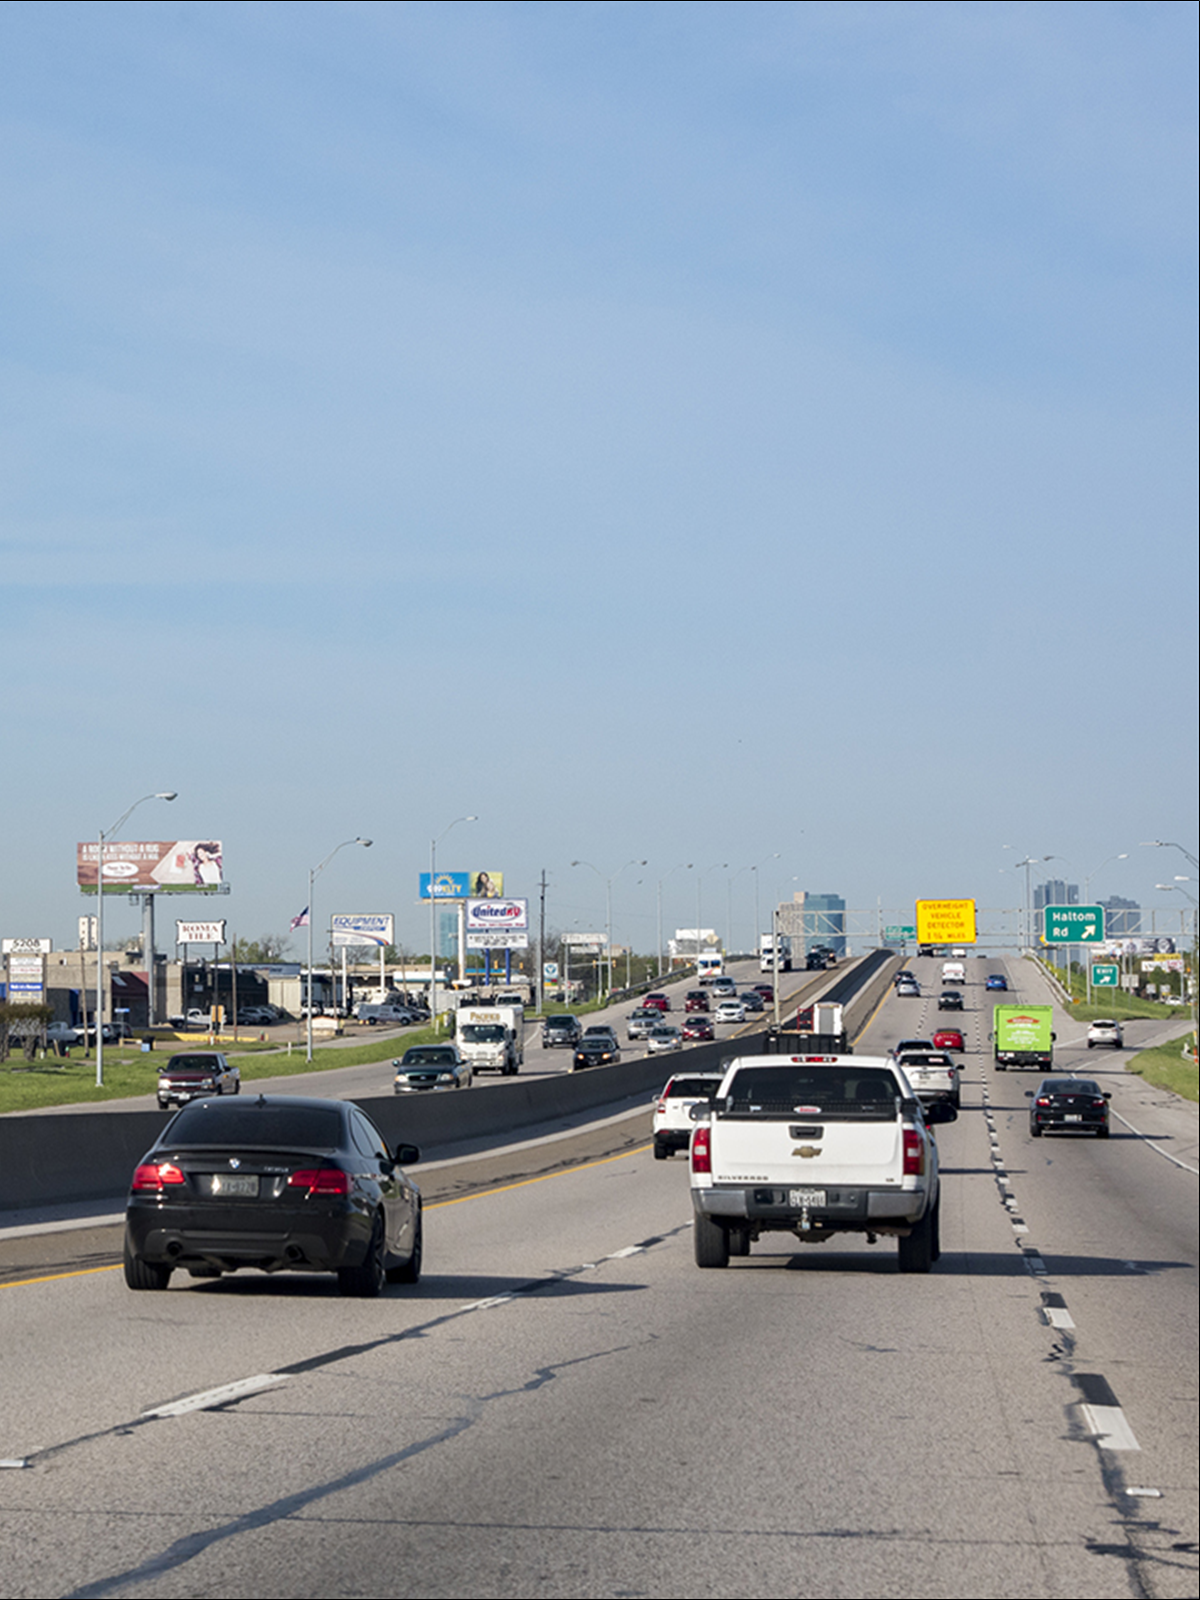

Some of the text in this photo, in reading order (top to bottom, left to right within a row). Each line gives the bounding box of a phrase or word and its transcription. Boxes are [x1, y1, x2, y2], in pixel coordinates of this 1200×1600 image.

[921, 902, 969, 911] OVERHEIGHT
[1052, 911, 1096, 921] Haltom
[333, 916, 390, 927] EQUIPMENT
[927, 921, 965, 929] DETECTOR
[1052, 927, 1069, 937] Rd
